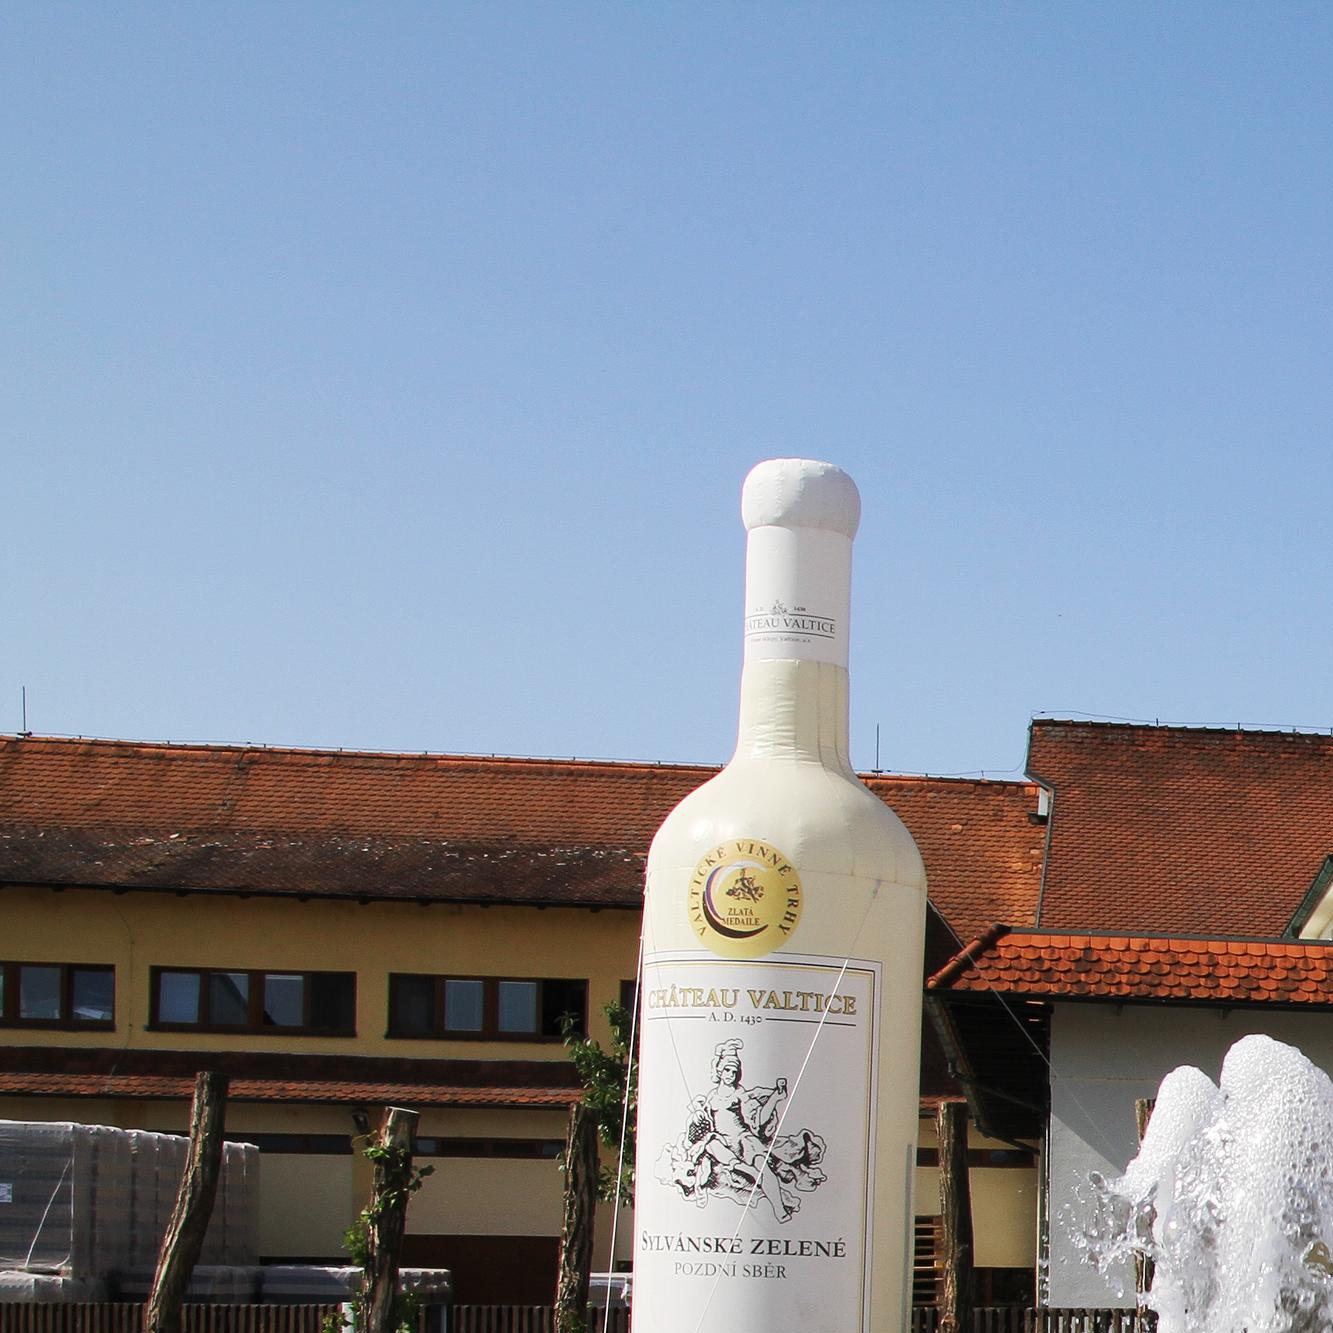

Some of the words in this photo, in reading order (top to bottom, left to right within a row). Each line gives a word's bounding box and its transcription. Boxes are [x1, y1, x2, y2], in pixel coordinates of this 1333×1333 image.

[783, 618, 836, 634] VALTICE
[778, 884, 800, 935] TRHY
[649, 984, 740, 1009] CHÂTEAU
[747, 989, 858, 1016] VALTICE
[740, 1015, 763, 1025] 1430
[642, 1231, 744, 1254] SYLVÁNSKÉ
[750, 1237, 847, 1258] ZELENÉ
[674, 1261, 737, 1277] POZDNÍ
[742, 1262, 788, 1279] SBĚR
